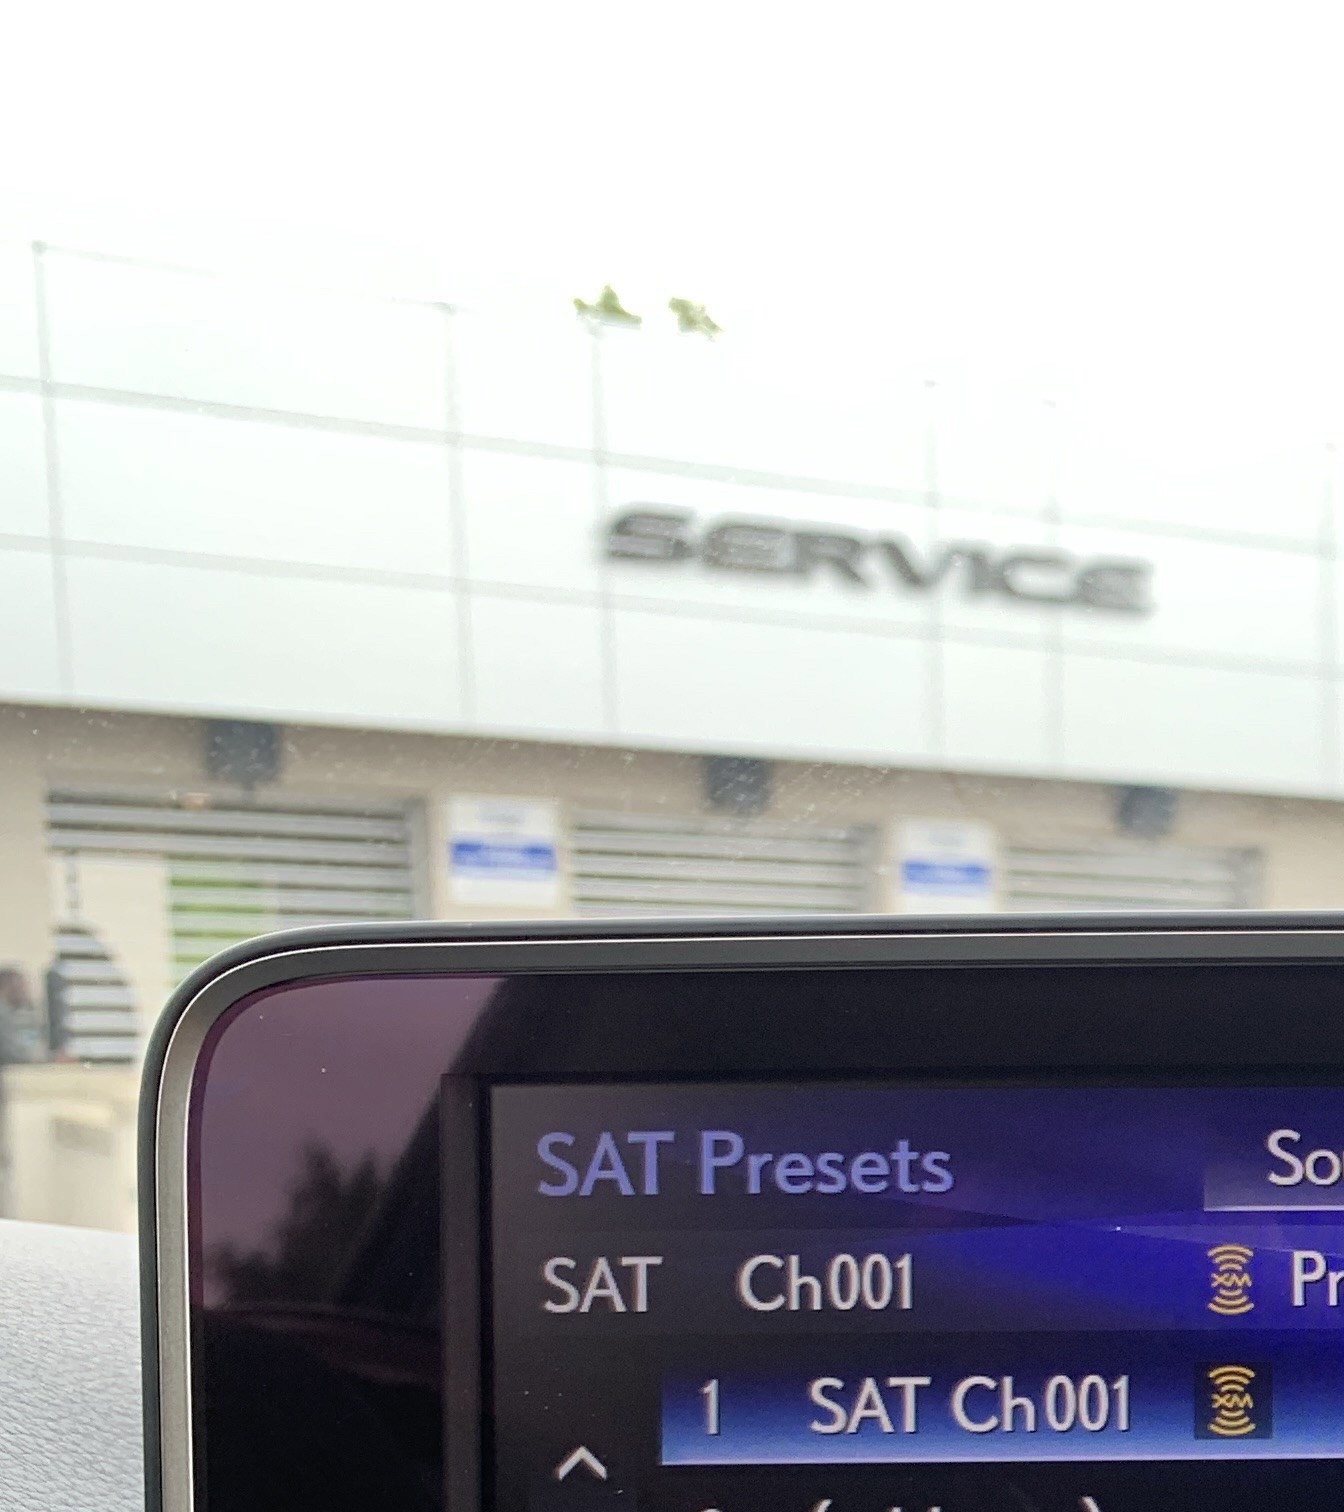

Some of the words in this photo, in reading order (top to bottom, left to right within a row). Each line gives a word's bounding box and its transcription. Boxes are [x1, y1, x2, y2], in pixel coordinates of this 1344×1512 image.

[605, 503, 1153, 613] SERVICE
[536, 1131, 675, 1197] SAT
[698, 1129, 954, 1195] Presets
[541, 1256, 664, 1314] SAT
[736, 1252, 915, 1311] Ch001
[701, 1379, 721, 1436] 1
[809, 1376, 931, 1434] SAT
[950, 1374, 1130, 1433] Ch001
